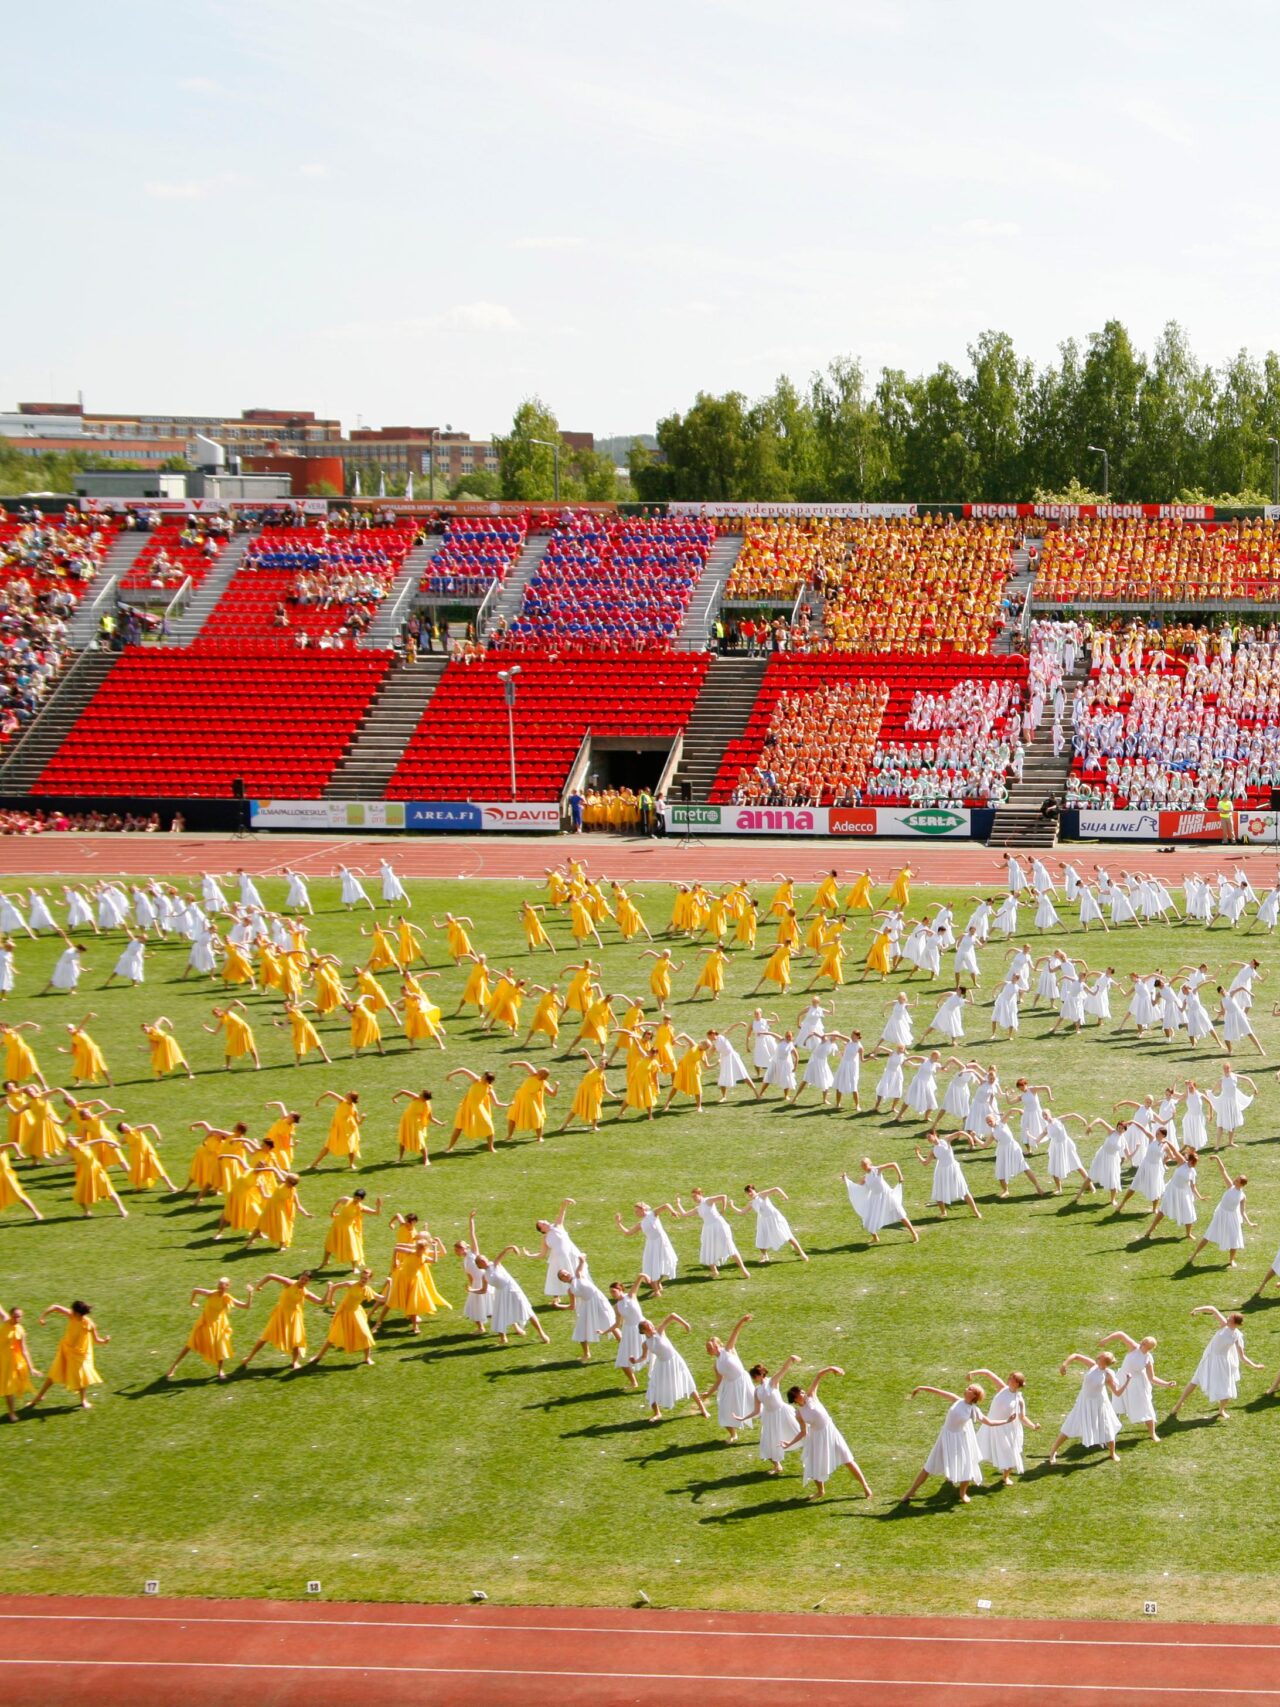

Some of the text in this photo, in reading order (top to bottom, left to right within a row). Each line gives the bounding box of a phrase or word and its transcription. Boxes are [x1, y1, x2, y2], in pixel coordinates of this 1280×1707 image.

[972, 505, 1017, 518] RICOH
[1034, 505, 1079, 518] RICOH
[1096, 505, 1142, 518] RICOH
[1160, 505, 1205, 519] RICOH
[413, 811, 474, 820] AREA.FI
[506, 810, 559, 820] DAVID
[736, 810, 814, 830] anna
[832, 821, 874, 832] Adecco
[1080, 822, 1136, 832] SILJA LINE
